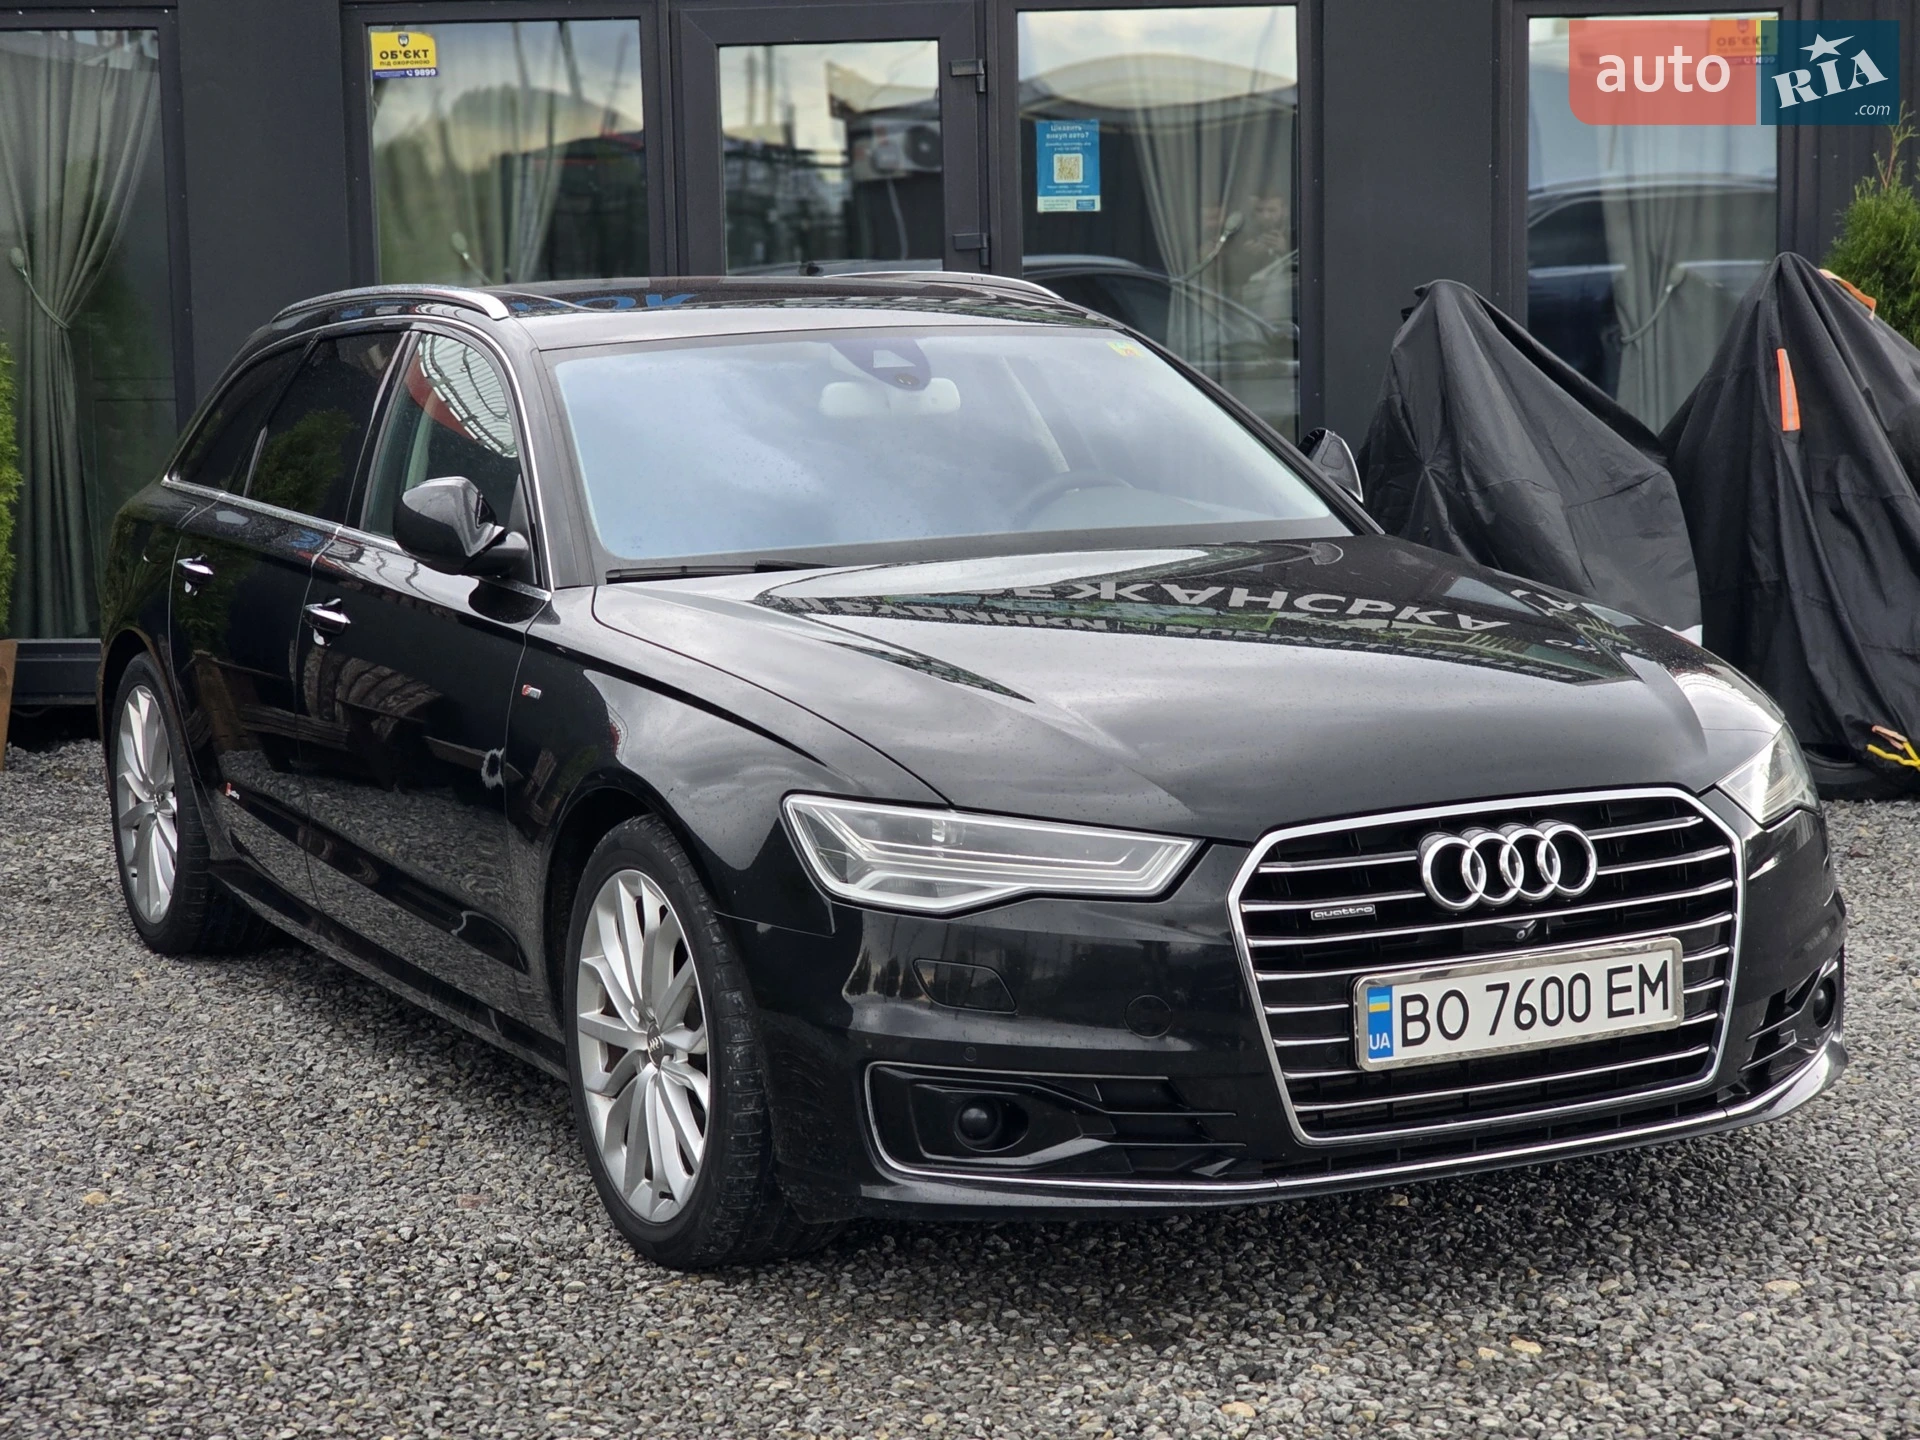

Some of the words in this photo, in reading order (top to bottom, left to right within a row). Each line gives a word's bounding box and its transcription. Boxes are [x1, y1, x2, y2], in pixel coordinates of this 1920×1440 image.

[379, 49, 429, 60] ОБ'ЄКТ
[414, 68, 436, 77] 9899
[1314, 906, 1373, 920] quattro
[1400, 989, 1470, 1048] BO
[1486, 972, 1592, 1037] 7600
[1606, 959, 1669, 1020] EM
[1369, 1032, 1391, 1050] UA
